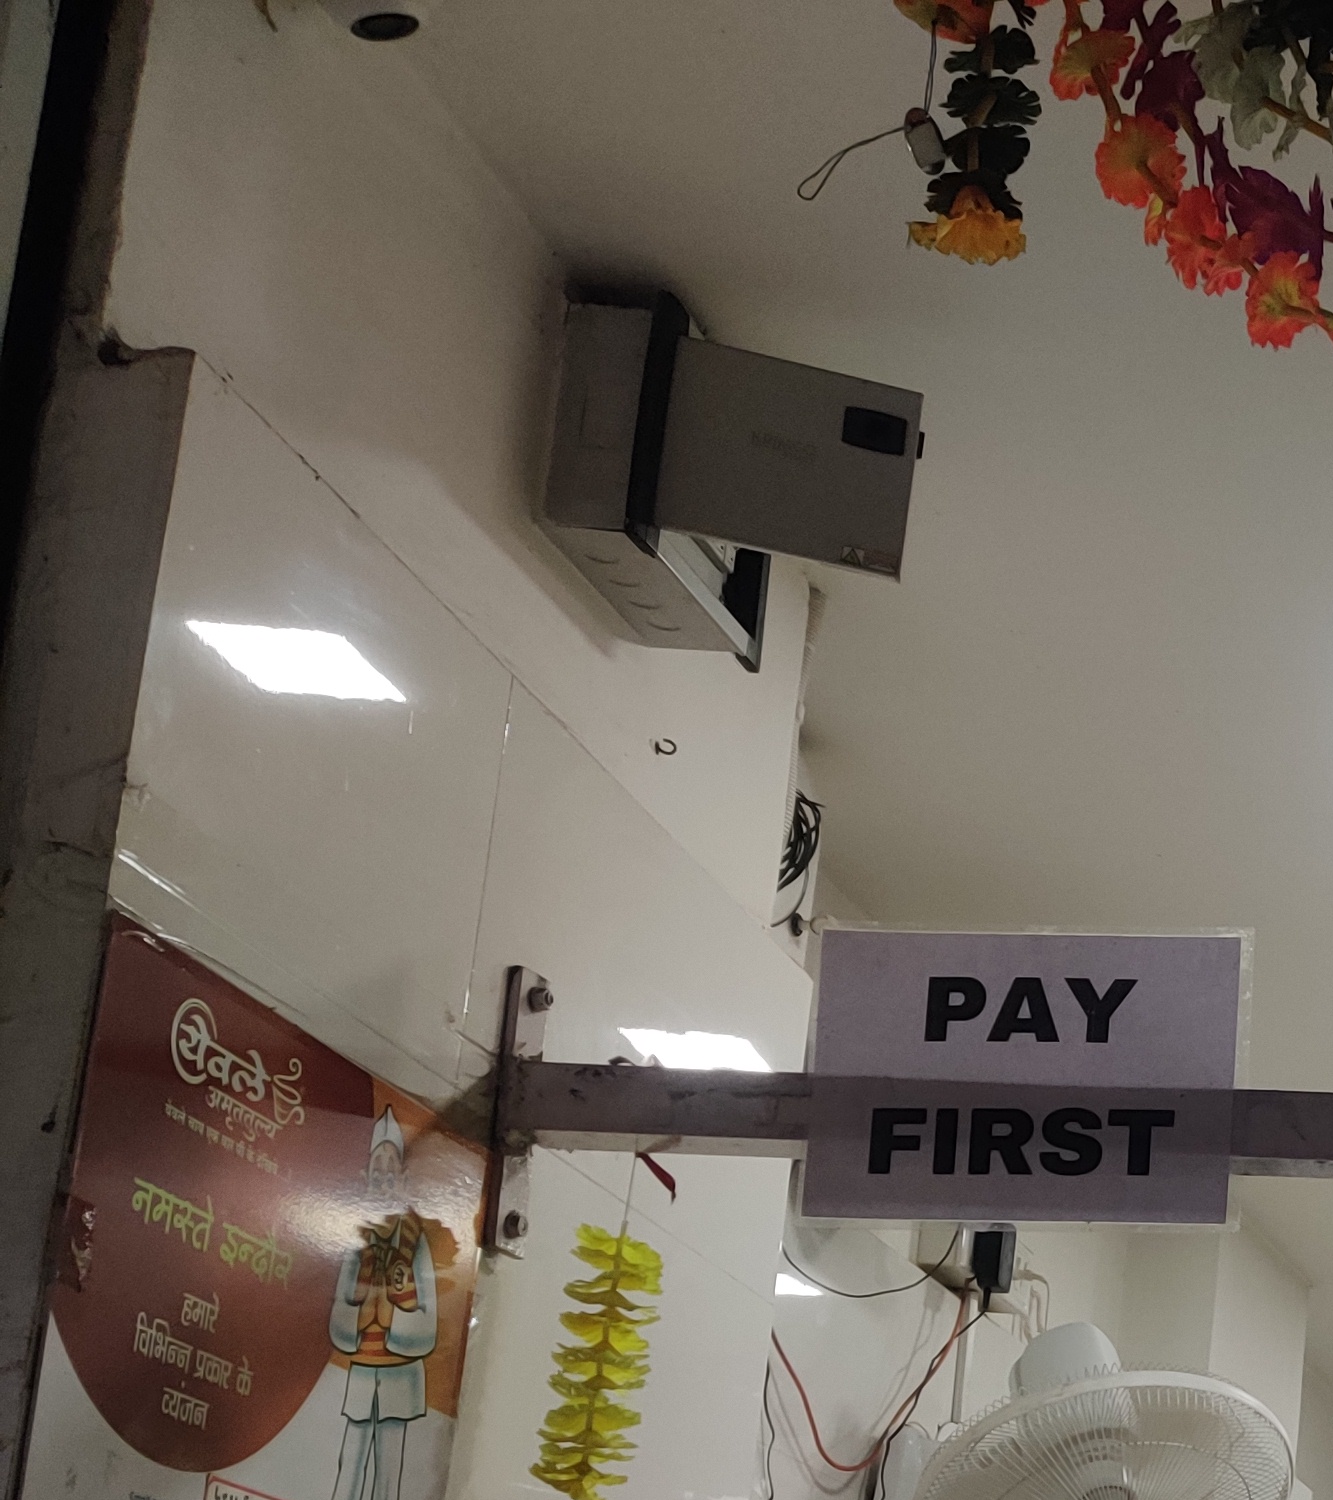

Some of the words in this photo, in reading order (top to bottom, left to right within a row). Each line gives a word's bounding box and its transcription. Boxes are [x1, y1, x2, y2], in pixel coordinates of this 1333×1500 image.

[924, 976, 1139, 1043] PAY
[868, 1107, 1175, 1176] FIRST
[131, 1178, 214, 1253] नमस्ते
[181, 1293, 220, 1335] हमारे
[134, 1311, 193, 1371] विभिन्न
[237, 1356, 254, 1396] के
[162, 1382, 209, 1429] व्यंजन
